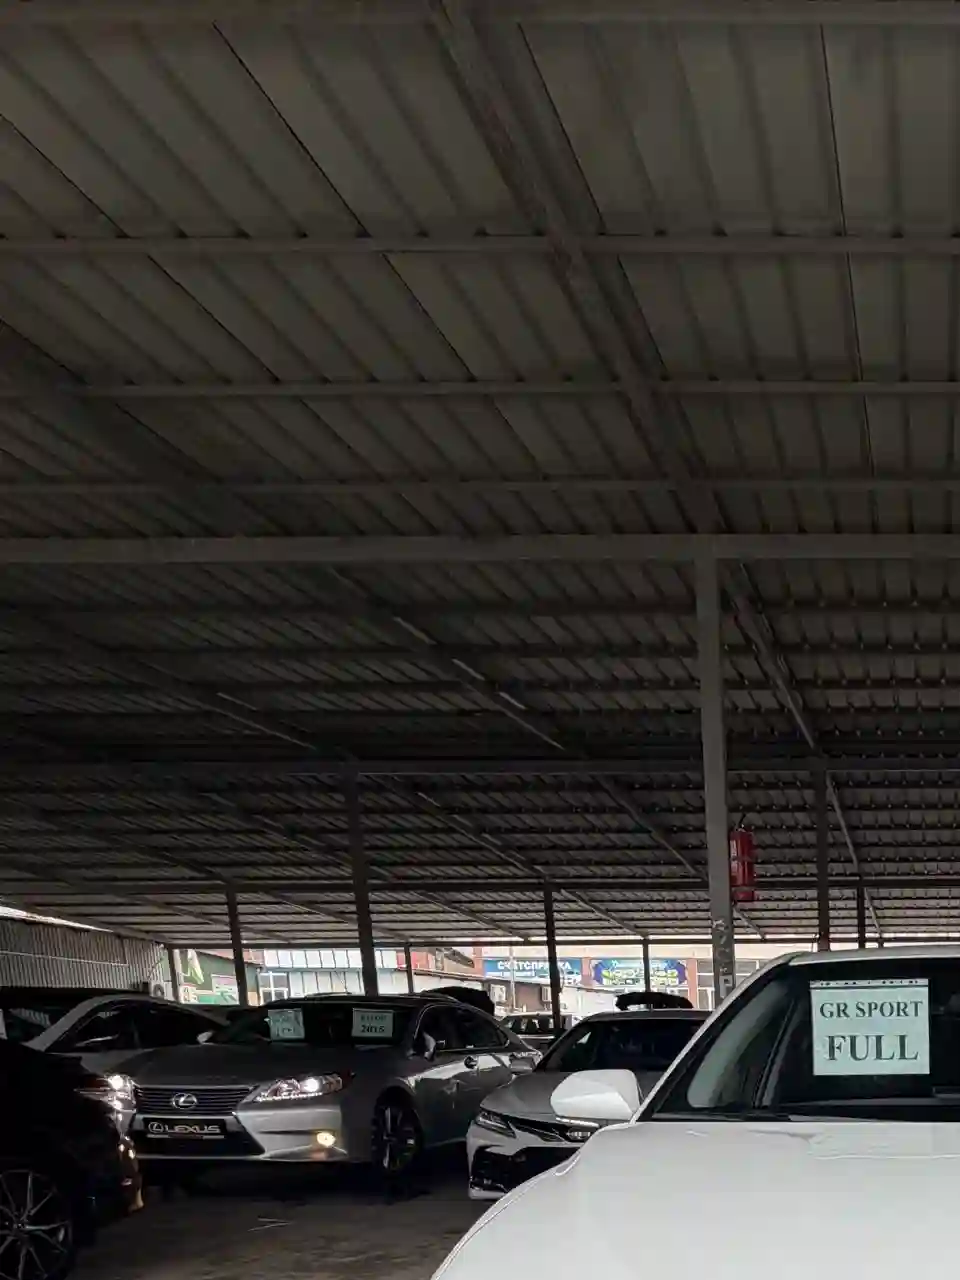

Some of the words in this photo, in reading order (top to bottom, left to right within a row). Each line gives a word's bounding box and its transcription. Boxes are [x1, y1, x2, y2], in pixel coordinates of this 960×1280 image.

[820, 1002, 850, 1018] GR
[855, 1001, 923, 1018] SPORT
[826, 1034, 919, 1061] FULL
[165, 1125, 221, 1134] LEXUS
